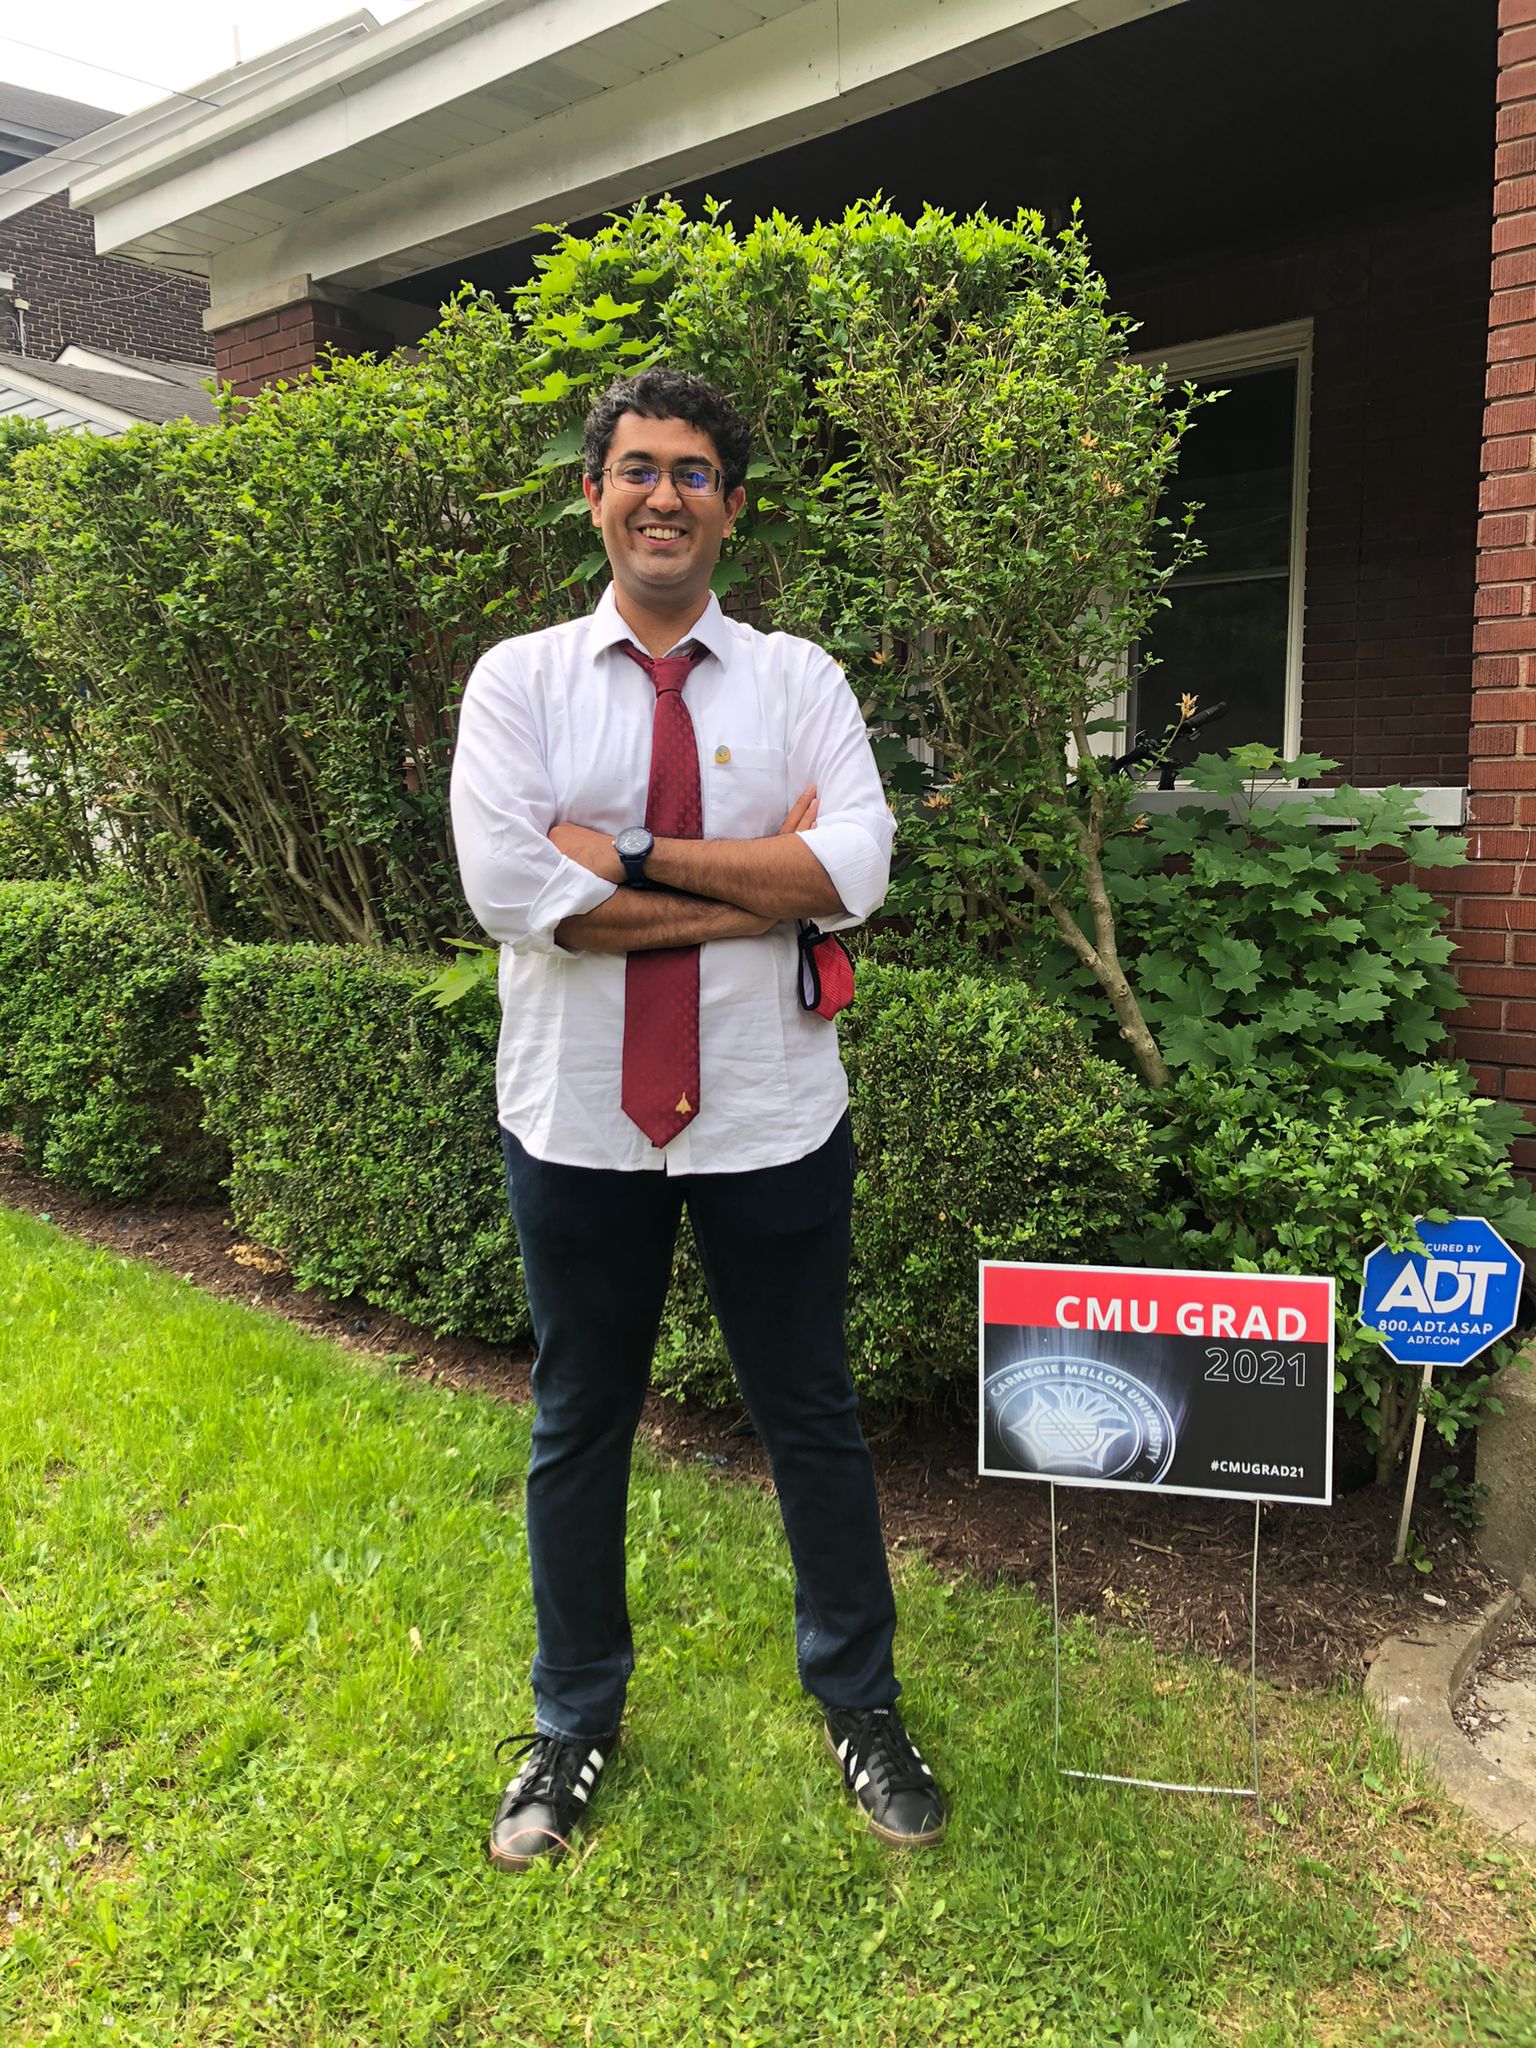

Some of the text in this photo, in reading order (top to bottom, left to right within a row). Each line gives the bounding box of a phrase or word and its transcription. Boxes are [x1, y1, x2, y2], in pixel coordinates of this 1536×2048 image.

[1421, 1242, 1481, 1253] CURED BY
[1375, 1259, 1507, 1315] ADT
[1055, 1296, 1307, 1342] CMU GRAD
[1378, 1319, 1493, 1335] 800.ADT.ASAP
[1407, 1335, 1460, 1346] ADT.COM
[1204, 1347, 1306, 1387] 2021
[990, 1363, 1162, 1464] CARNEGIE MELLON UNIVERSITY
[1210, 1460, 1305, 1478] #CMUGRAD21
